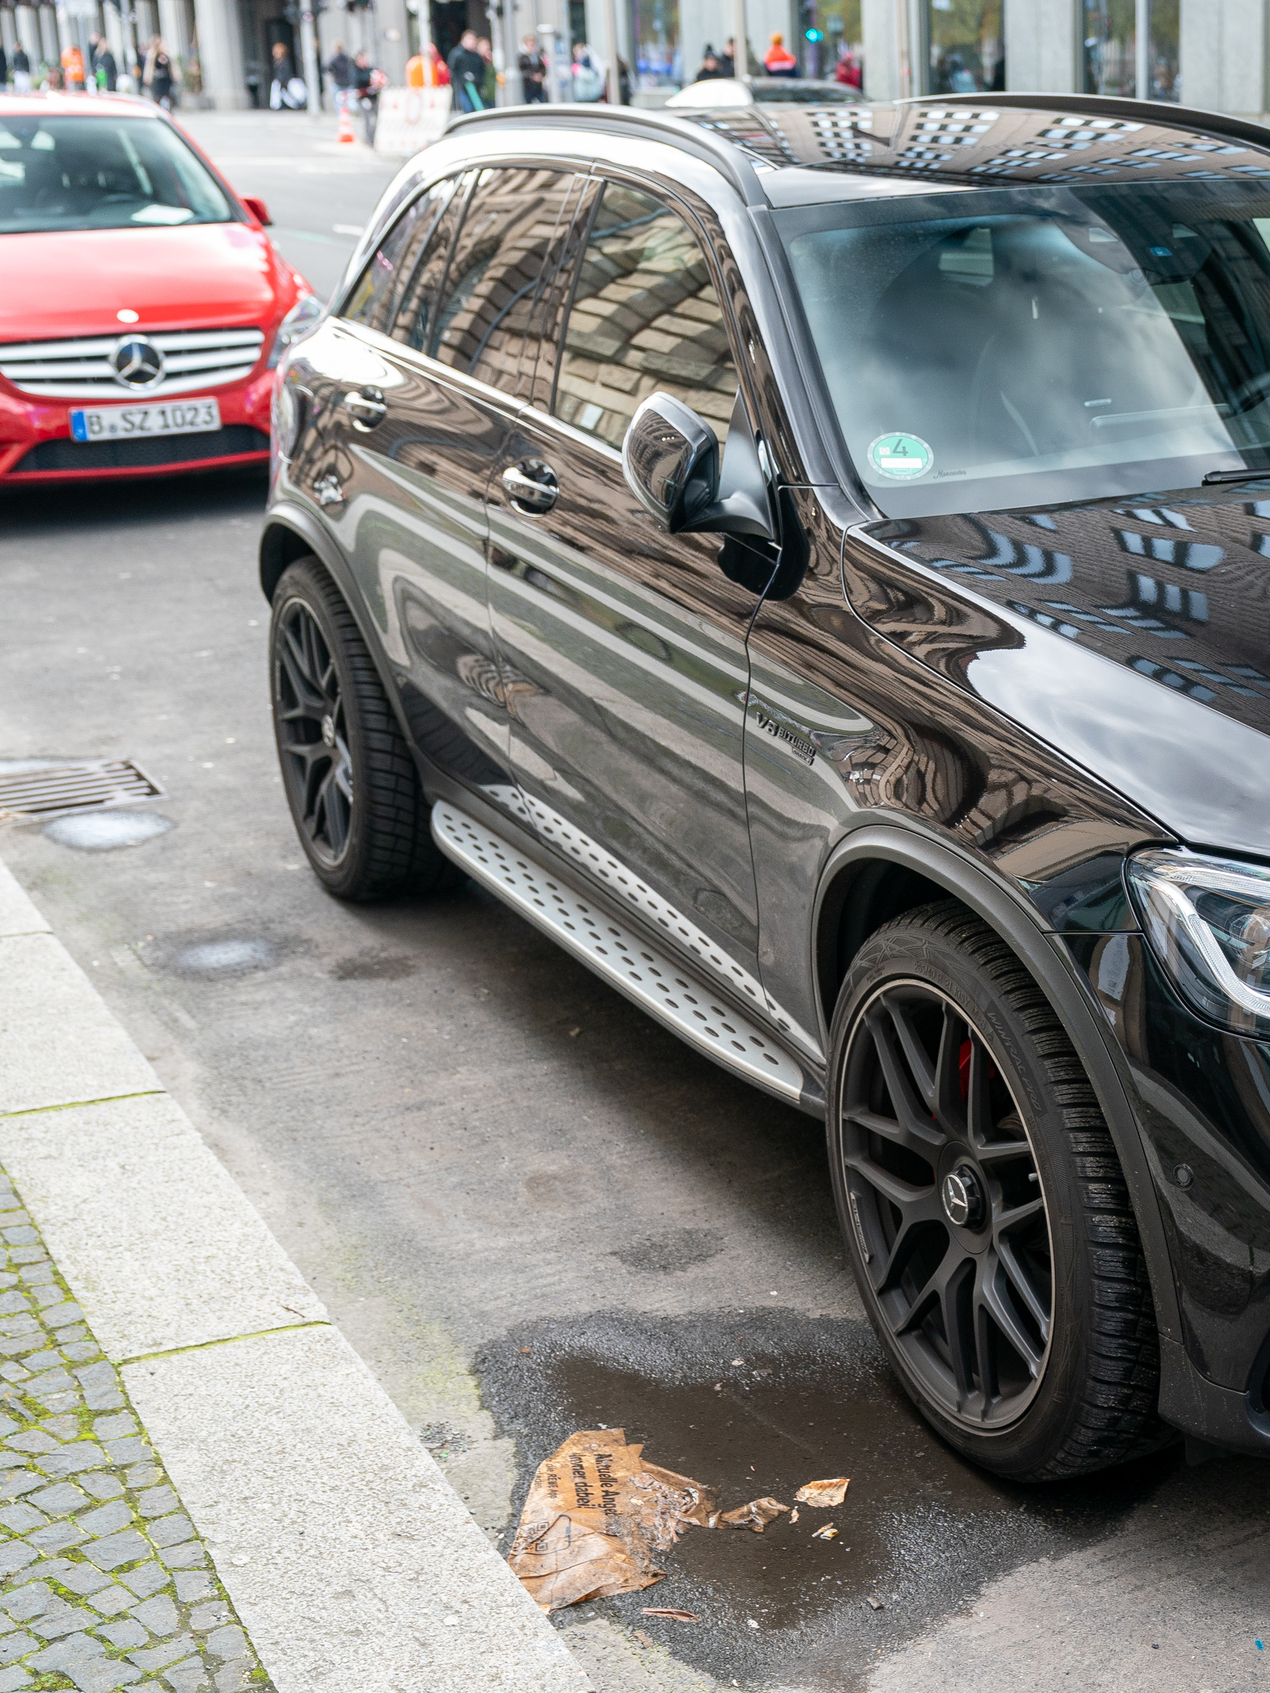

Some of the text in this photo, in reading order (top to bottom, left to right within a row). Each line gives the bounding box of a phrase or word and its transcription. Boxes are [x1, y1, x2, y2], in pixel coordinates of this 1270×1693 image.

[87, 415, 103, 435] B
[121, 411, 152, 433] SZ
[159, 405, 215, 430] 1023
[892, 438, 908, 457] 4
[756, 711, 780, 736] V8
[779, 727, 816, 757] BITURBO
[987, 1012, 1026, 1077] WINTRAC
[1022, 1076, 1042, 1112] PRO
[574, 1481, 597, 1509] dabei!
